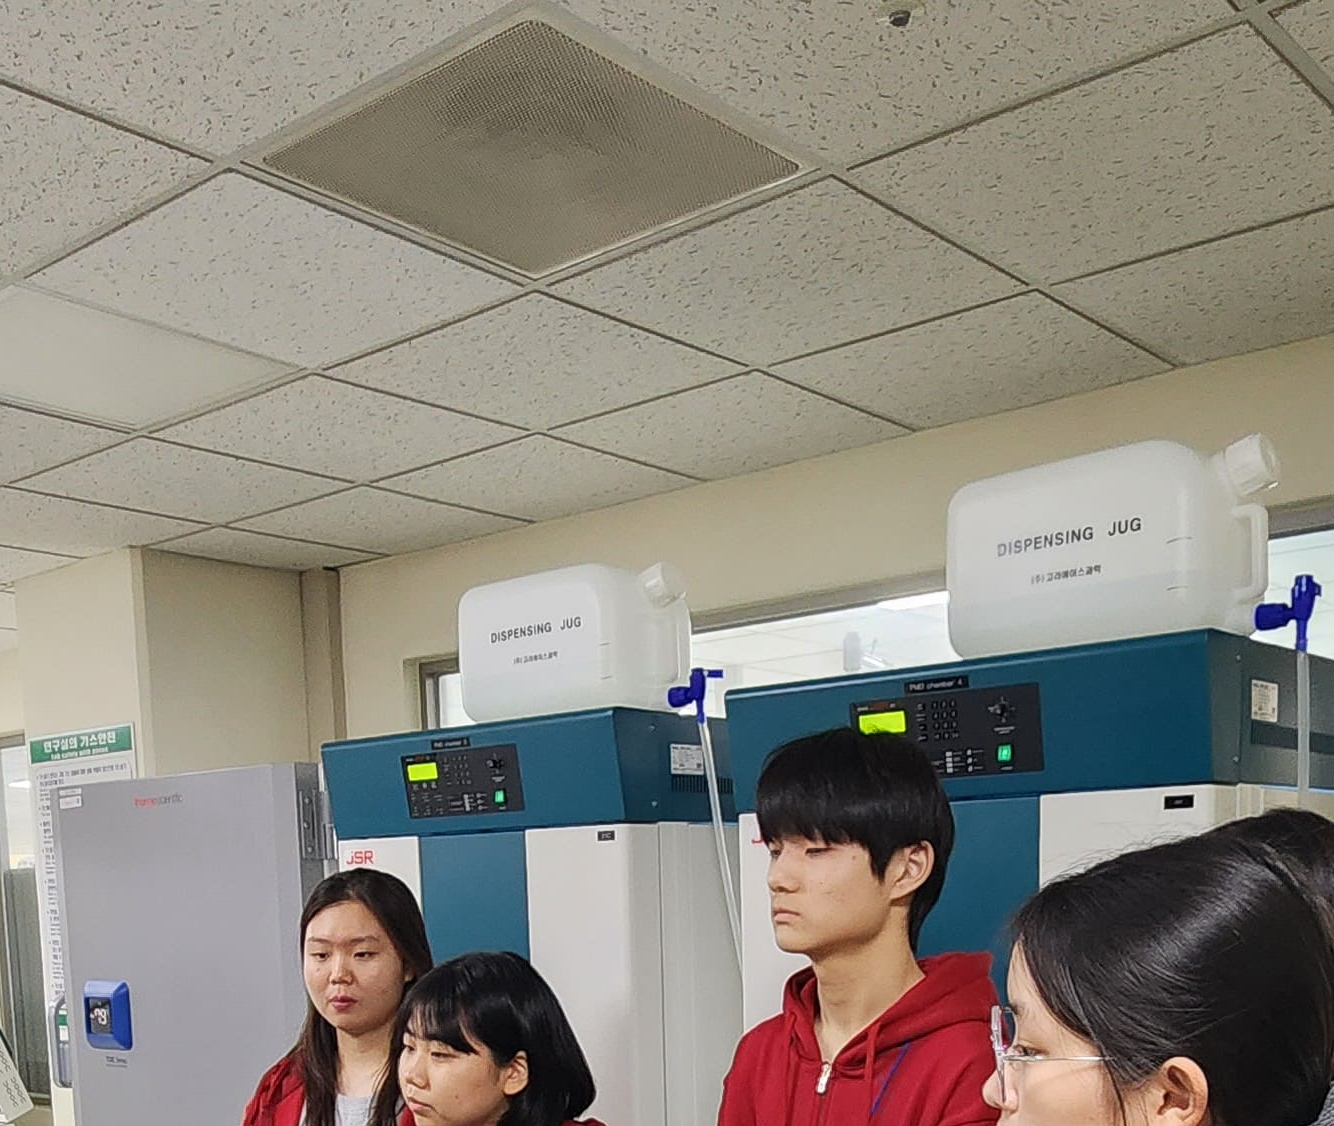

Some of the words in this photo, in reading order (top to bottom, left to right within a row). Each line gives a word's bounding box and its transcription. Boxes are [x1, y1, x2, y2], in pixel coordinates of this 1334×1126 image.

[997, 526, 1094, 557] DISPENSING
[1108, 517, 1142, 537] JUG
[490, 622, 553, 643] DISPENSING
[560, 616, 582, 631] JUG
